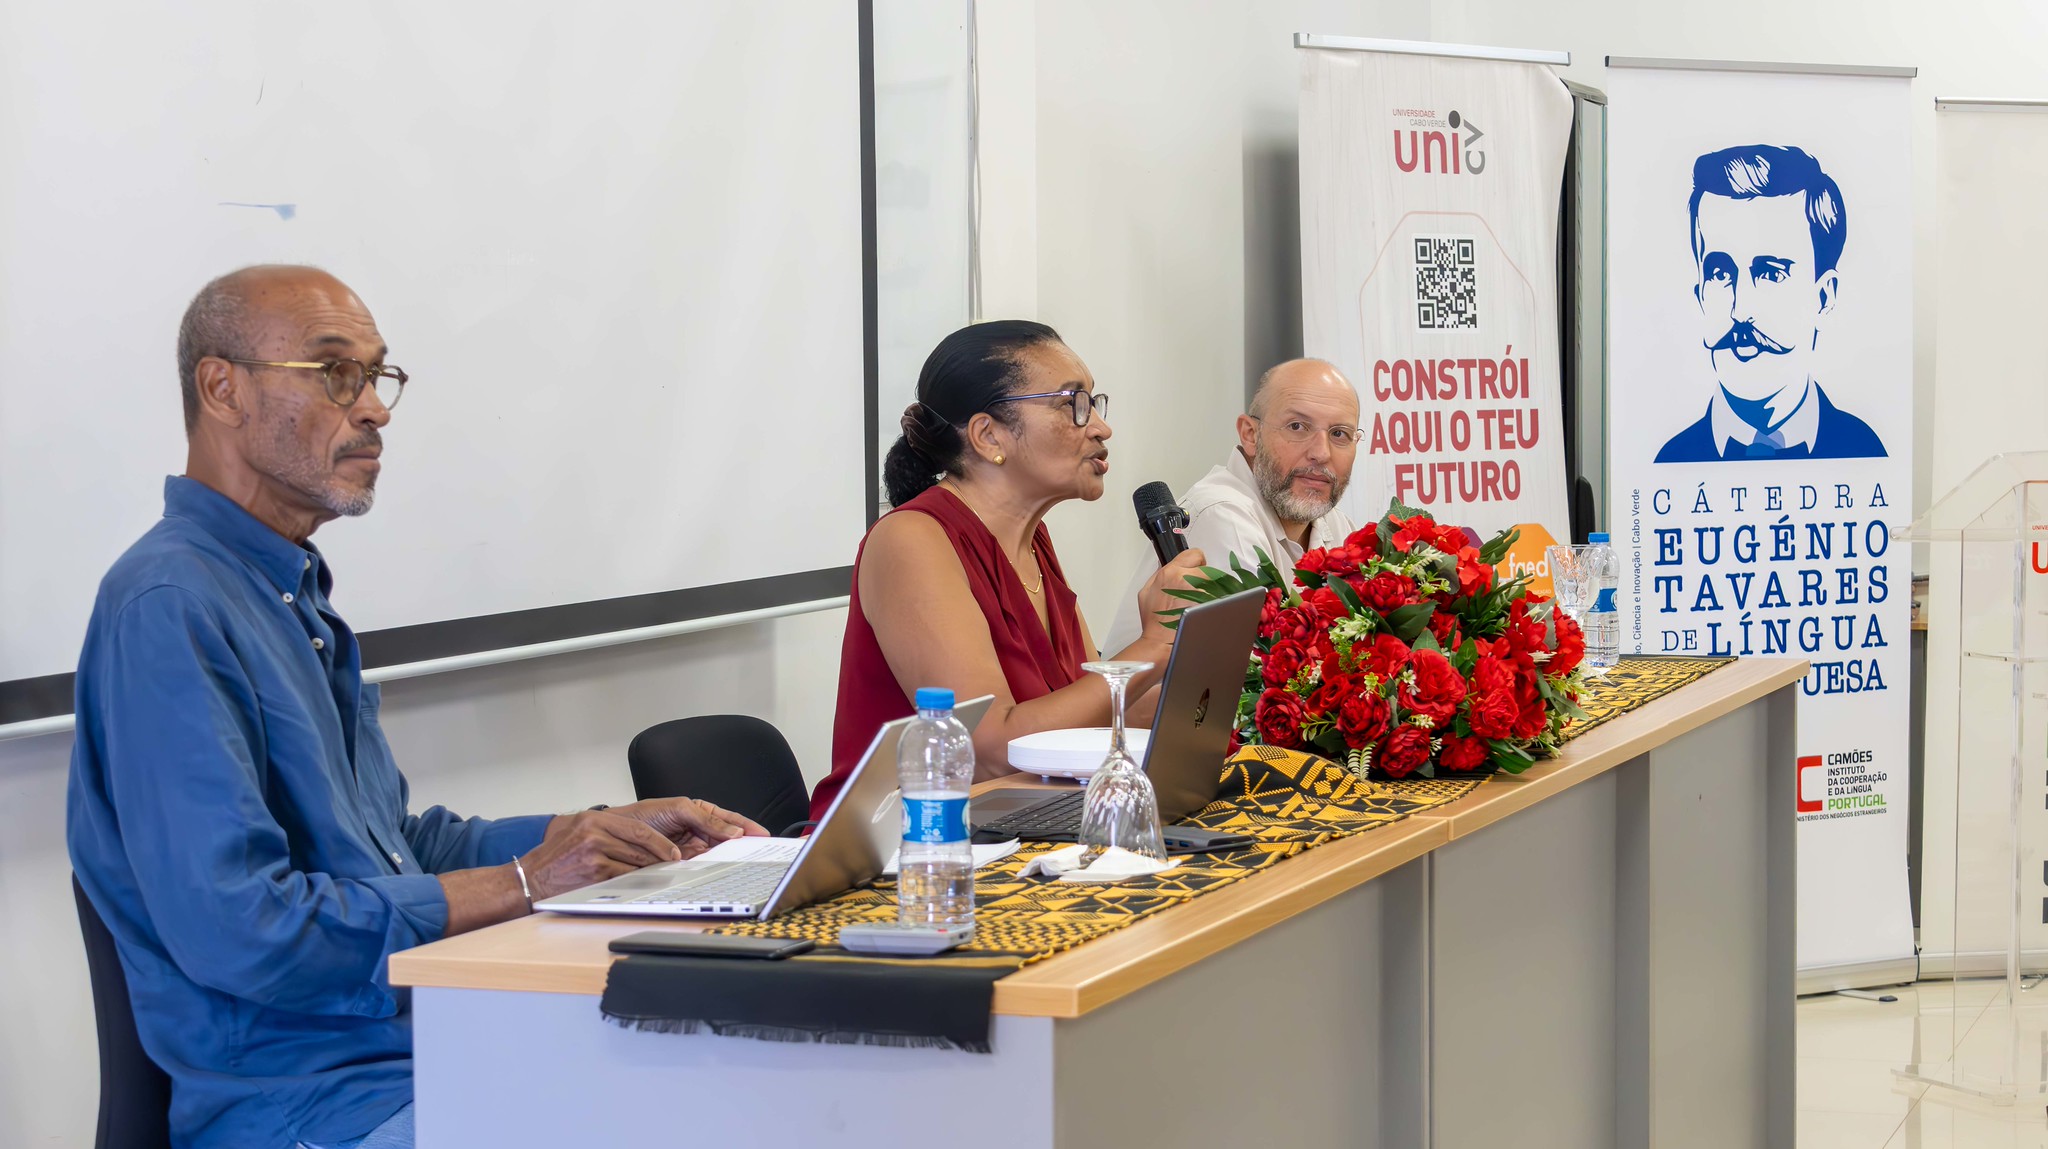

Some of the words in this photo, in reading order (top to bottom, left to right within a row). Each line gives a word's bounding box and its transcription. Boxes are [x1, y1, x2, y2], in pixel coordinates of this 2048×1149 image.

[1392, 109, 1435, 118] UNIVERSIDADE
[1409, 119, 1427, 127] CABO
[1427, 120, 1446, 128] VERDE
[1373, 345, 1530, 402] CONSTRÓI
[1369, 411, 1443, 455] AQUI
[1449, 410, 1471, 452] O
[1476, 408, 1539, 450] TEU
[1395, 459, 1521, 505] FUTURO
[1631, 488, 1640, 517] Verde
[1653, 482, 1889, 515] CÁTEDRA
[1632, 518, 1641, 543] Cabo
[1654, 514, 1889, 566] EUGÉNIO
[1632, 551, 1643, 595] Inovação
[1654, 565, 1889, 613] TAVARES
[1632, 605, 1642, 640] Ciência
[1661, 629, 1698, 651] DE
[1707, 611, 1888, 656] LÍNGUA
[1798, 658, 1888, 696] UESA
[1827, 749, 1873, 766] CAMÕES
[1827, 765, 1866, 777] INSTITUTO
[1827, 777, 1839, 787] DA
[1839, 771, 1888, 785] COOPERAÇÃO
[1828, 788, 1833, 796] E
[1834, 787, 1845, 796] DA
[1828, 794, 1888, 811] PORTUGAL
[1829, 810, 1854, 819] NEGÓCIOS
[1854, 808, 1887, 817] ESTRANGEIROS
